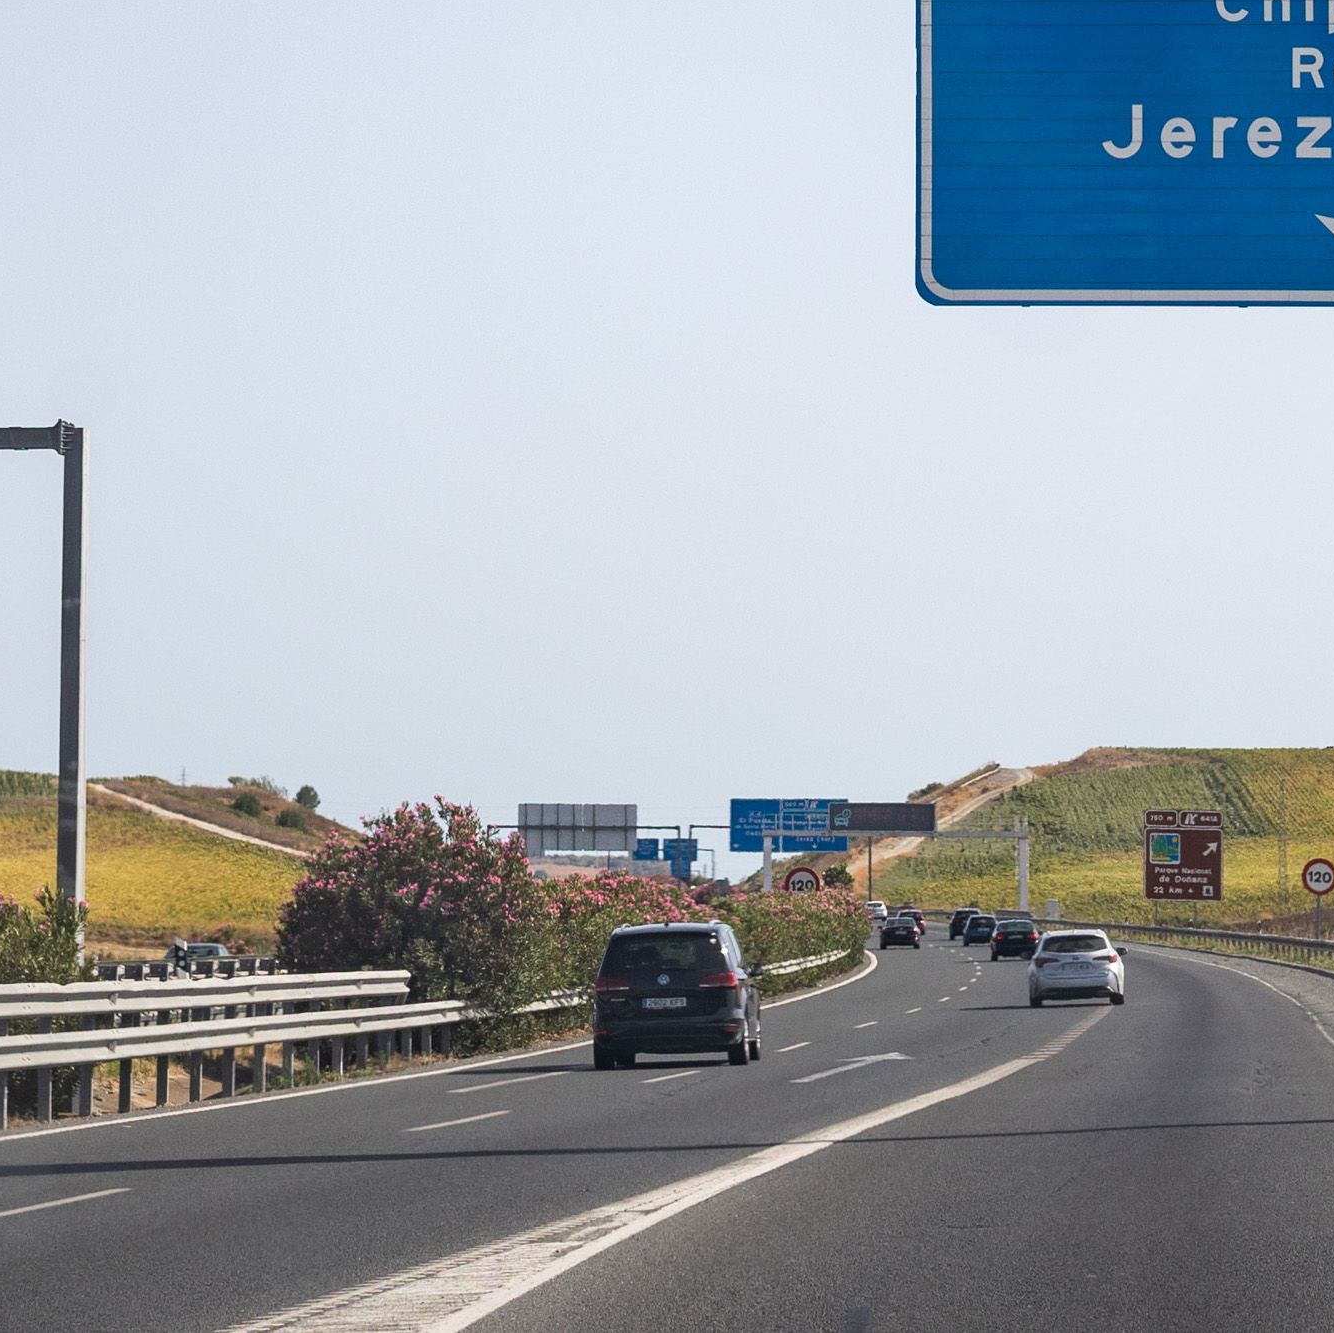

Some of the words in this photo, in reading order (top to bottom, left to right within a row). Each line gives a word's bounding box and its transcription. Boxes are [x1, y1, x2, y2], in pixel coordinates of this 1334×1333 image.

[1102, 104, 1333, 159] Jerez
[1158, 875, 1170, 883] de
[1308, 871, 1332, 883] 120
[790, 879, 814, 891] 120
[1153, 886, 1164, 894] 22
[1168, 886, 1183, 894] km
